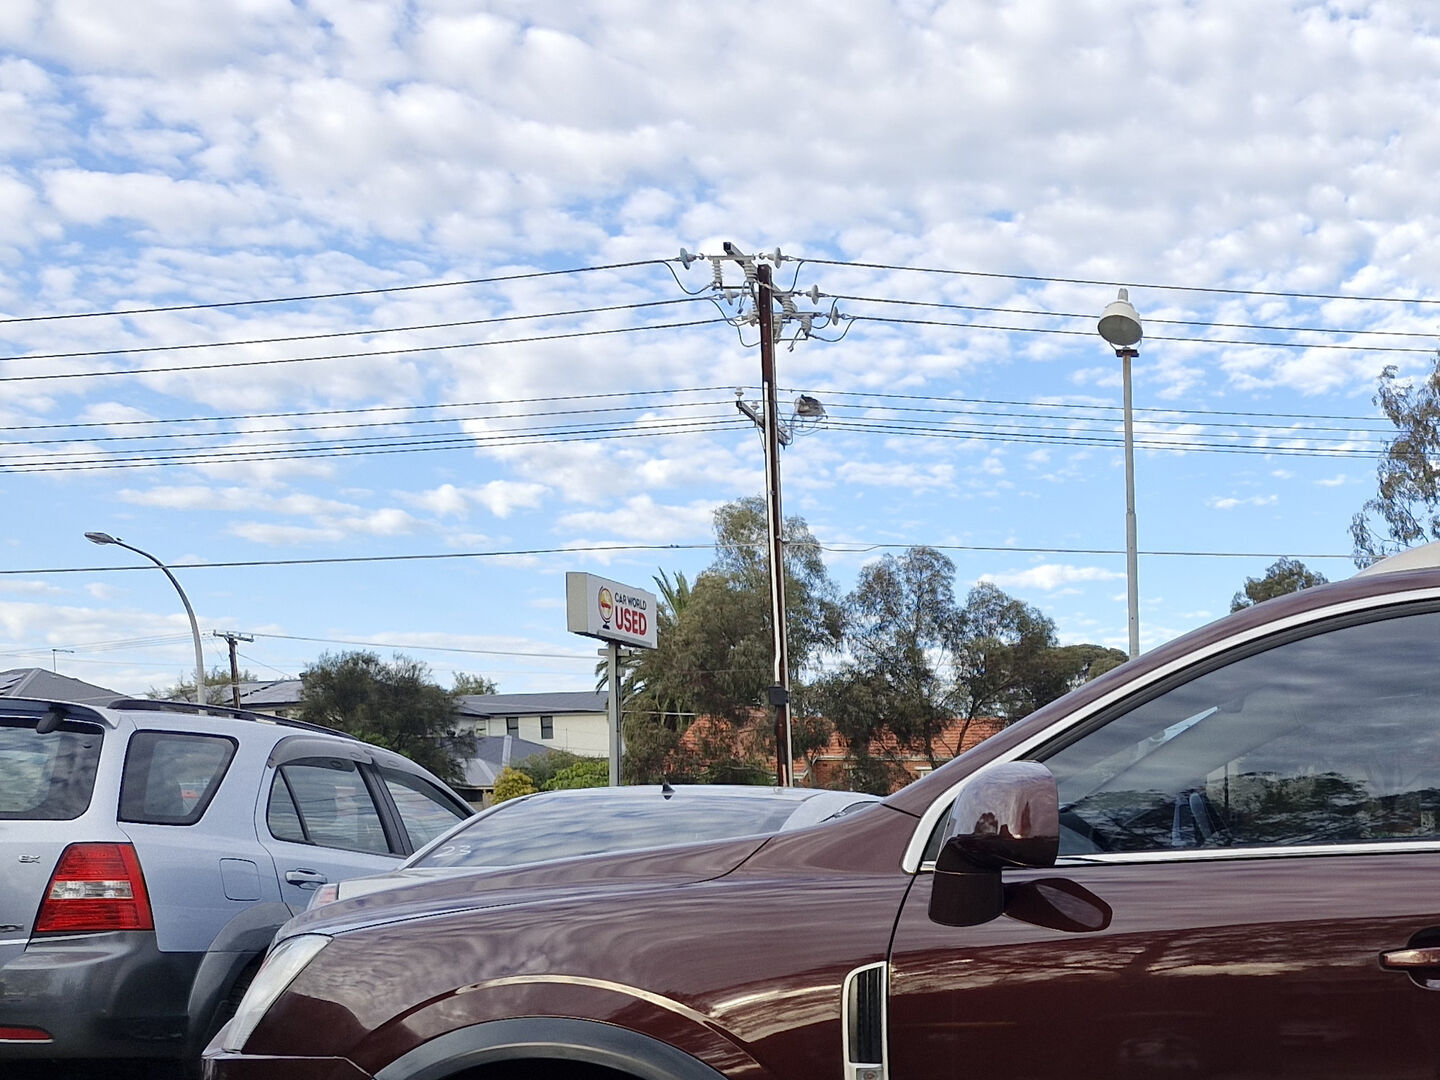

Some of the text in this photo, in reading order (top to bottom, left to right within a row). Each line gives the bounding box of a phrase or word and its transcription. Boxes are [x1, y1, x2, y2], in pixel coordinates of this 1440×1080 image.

[615, 592, 647, 611] CAR WORLD
[615, 605, 647, 636] USED
